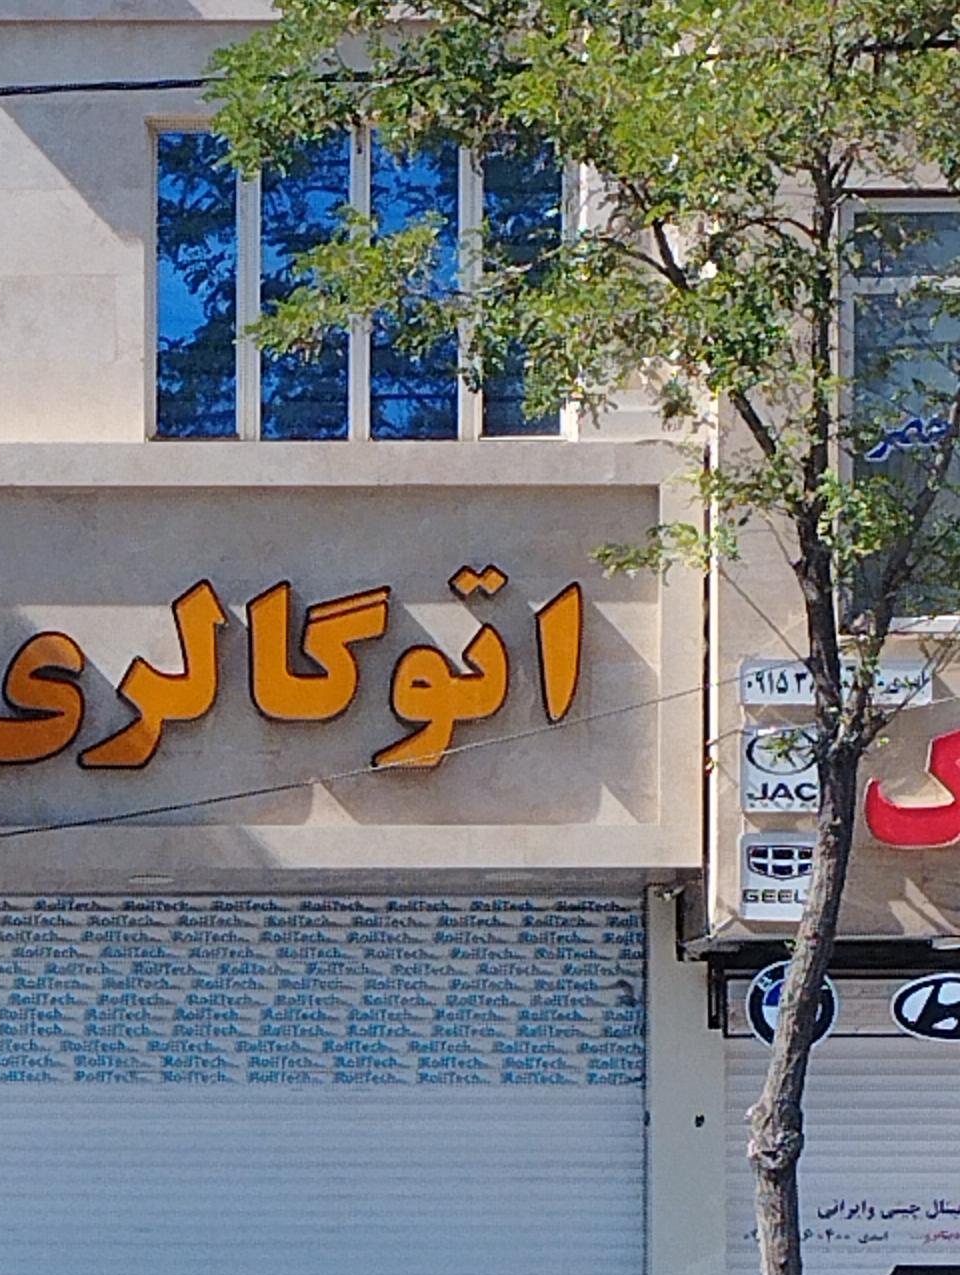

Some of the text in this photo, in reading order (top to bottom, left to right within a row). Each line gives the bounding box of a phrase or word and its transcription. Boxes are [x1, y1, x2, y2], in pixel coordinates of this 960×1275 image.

[746, 783, 818, 802] JAC
[742, 888, 807, 904] GEEL
[606, 915, 640, 928] Roll
